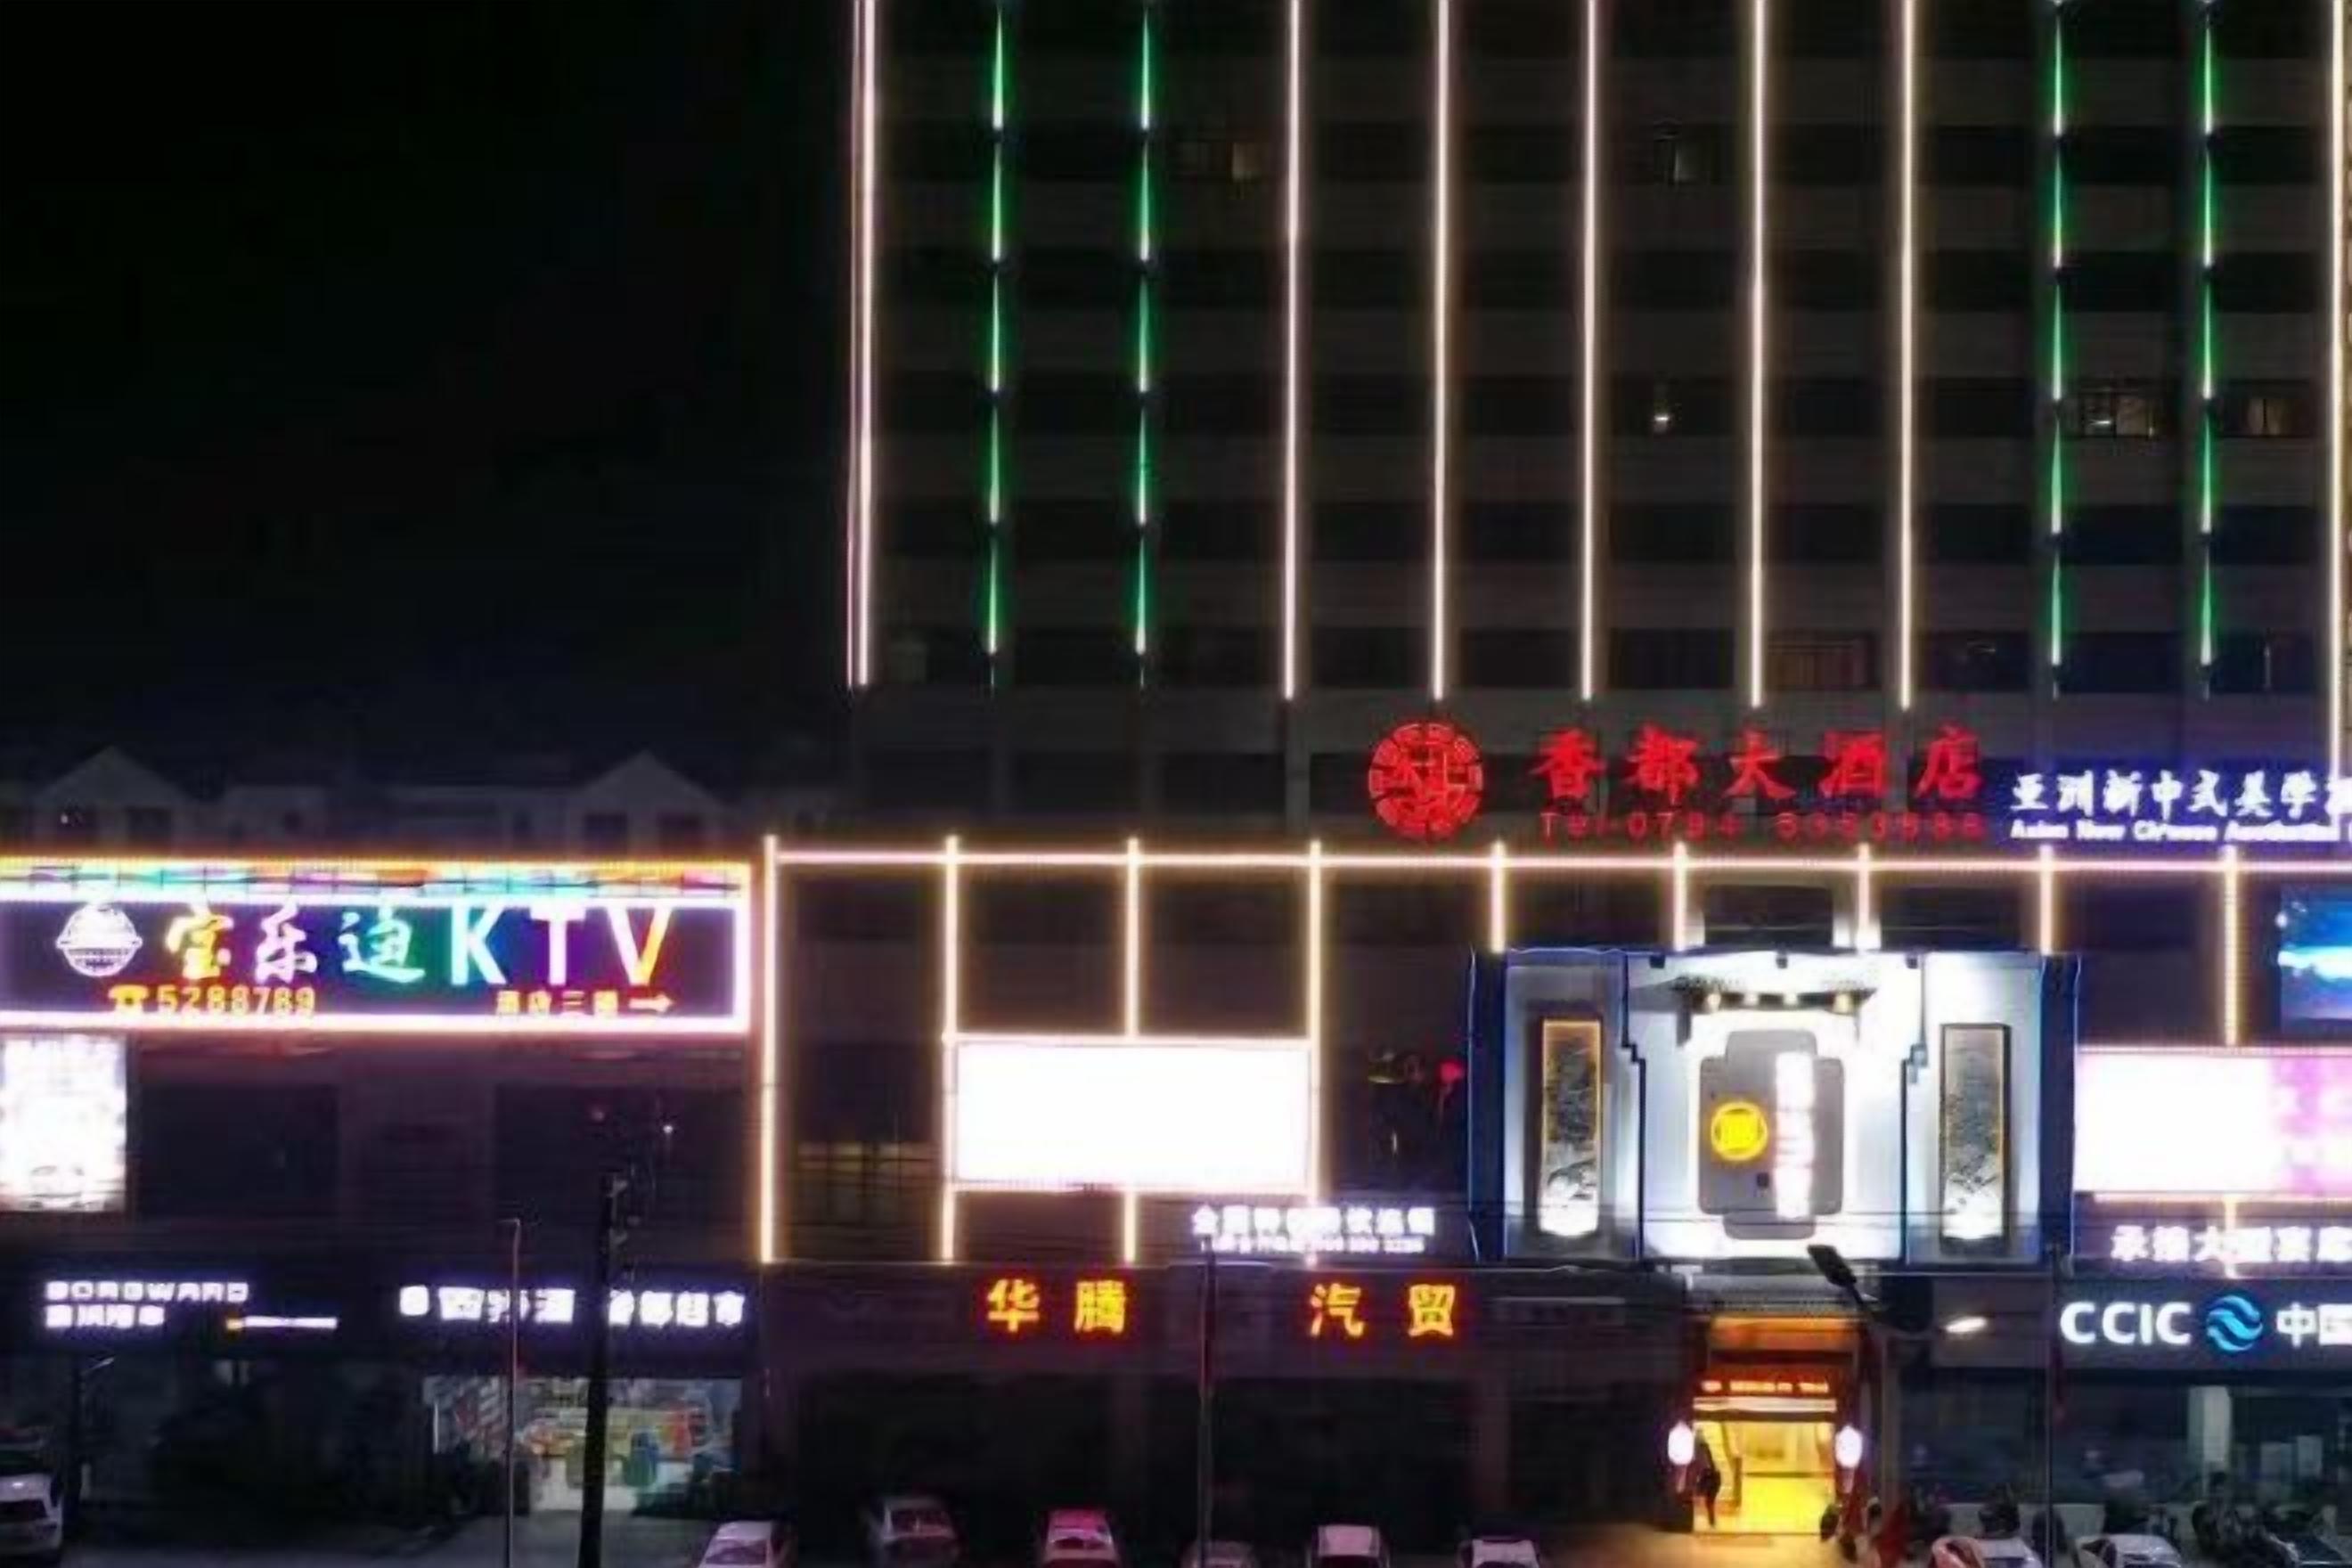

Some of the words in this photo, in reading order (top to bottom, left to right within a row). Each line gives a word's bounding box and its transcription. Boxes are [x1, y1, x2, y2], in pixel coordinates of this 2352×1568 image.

[1531, 723, 1984, 804] 香都大酒店
[987, 1278, 1126, 1334] 华腾
[2060, 1301, 2191, 1344] CCIC
